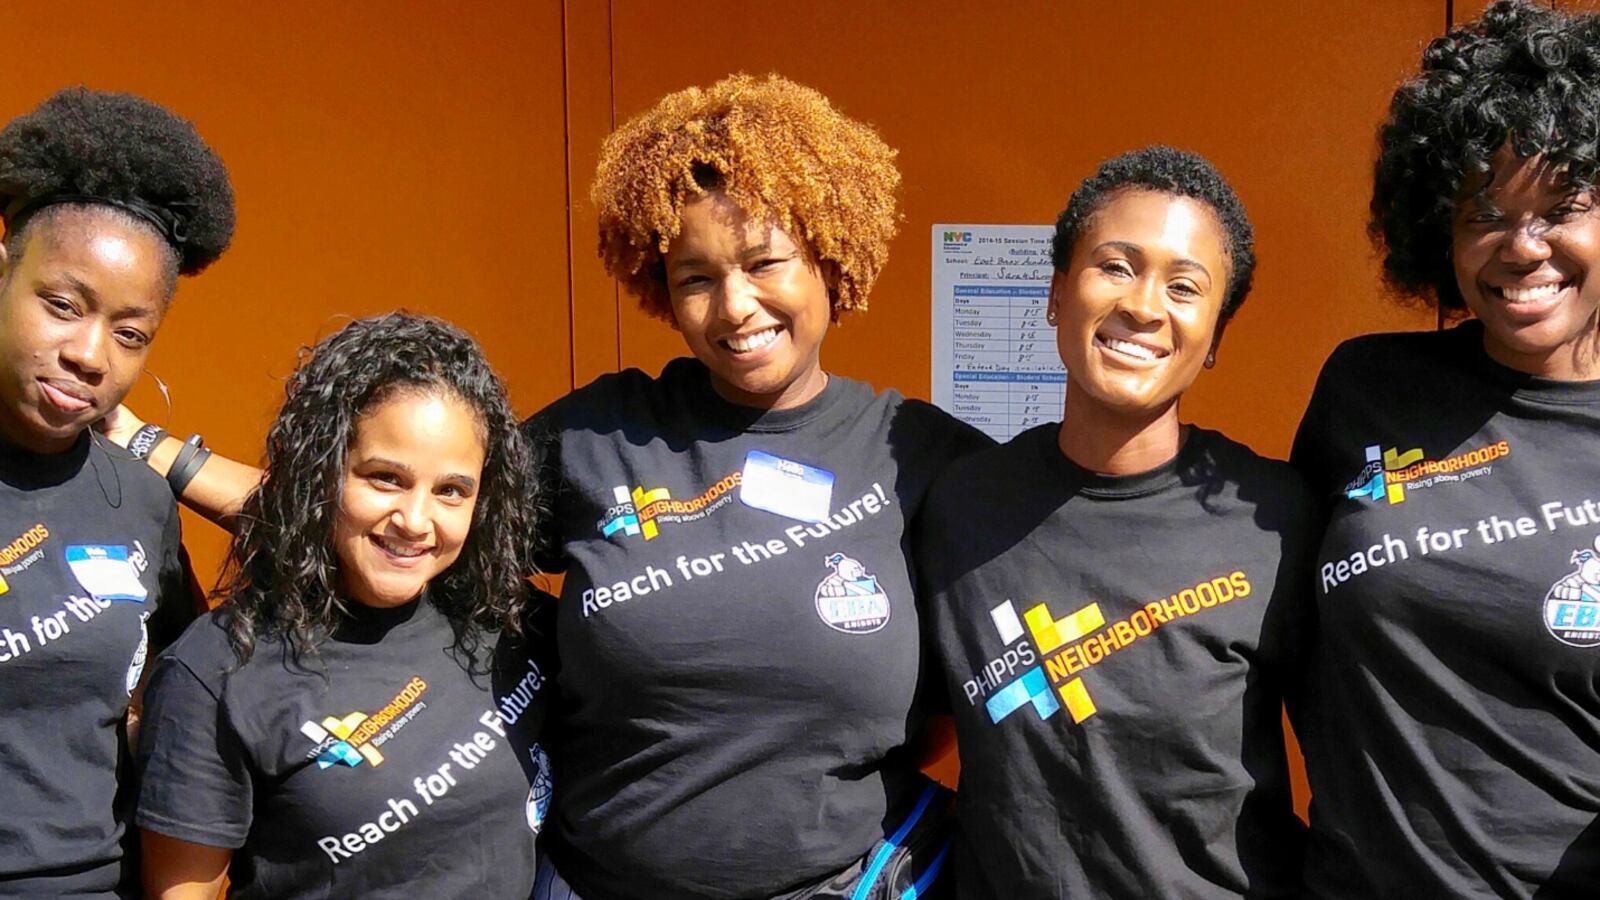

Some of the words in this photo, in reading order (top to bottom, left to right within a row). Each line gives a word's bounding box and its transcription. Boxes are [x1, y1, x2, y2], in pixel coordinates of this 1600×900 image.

[944, 232, 972, 242] NYC
[955, 308, 980, 316] Monday
[955, 319, 982, 327] Tuesday
[955, 393, 979, 401] Monday
[955, 404, 981, 412] Tuesday
[1385, 440, 1510, 483] NEIGHBORHOODS
[1406, 475, 1433, 490] Rising
[1433, 473, 1460, 483] above
[1460, 465, 1492, 482] poverty
[637, 471, 743, 523] NEIGHBORHOODS
[705, 495, 732, 516] poverty
[582, 565, 673, 617] Reach
[676, 551, 726, 581] for
[731, 537, 788, 566] the
[784, 482, 890, 547] Future!
[1320, 534, 1409, 594] Reach
[1416, 526, 1469, 556] for
[1476, 515, 1538, 545] the
[31, 610, 70, 646] for
[962, 640, 1036, 706] PHIPPS
[1044, 571, 1251, 683] NEIGHBORHOODS
[347, 676, 429, 748] NEIGHBORHOODS
[318, 798, 419, 864] Reach
[413, 763, 457, 805] for
[448, 731, 496, 770] the
[479, 659, 546, 738] Future!
